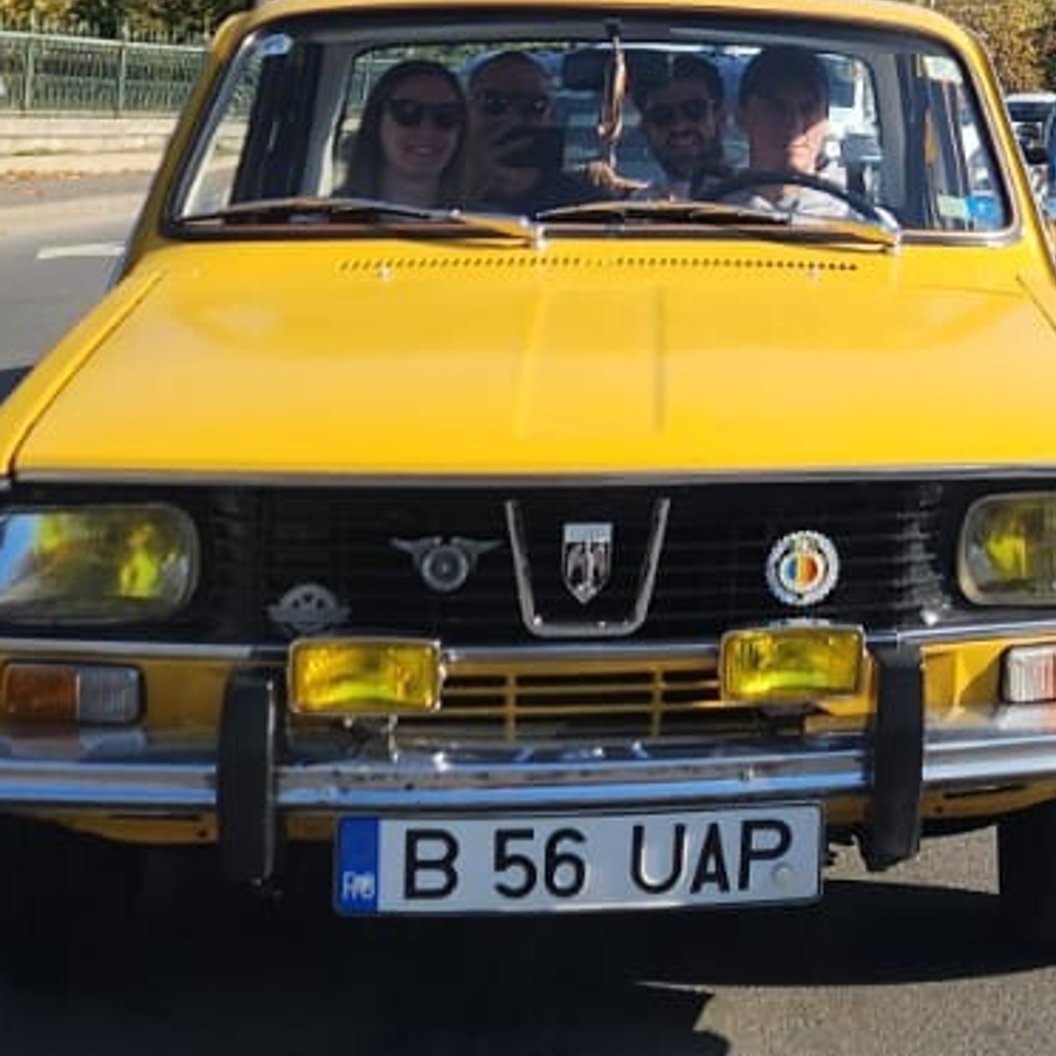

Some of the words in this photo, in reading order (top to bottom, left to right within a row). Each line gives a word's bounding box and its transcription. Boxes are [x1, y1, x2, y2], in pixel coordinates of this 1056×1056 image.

[404, 828, 460, 900] B
[494, 828, 586, 899] 56
[630, 819, 793, 896] UAP
